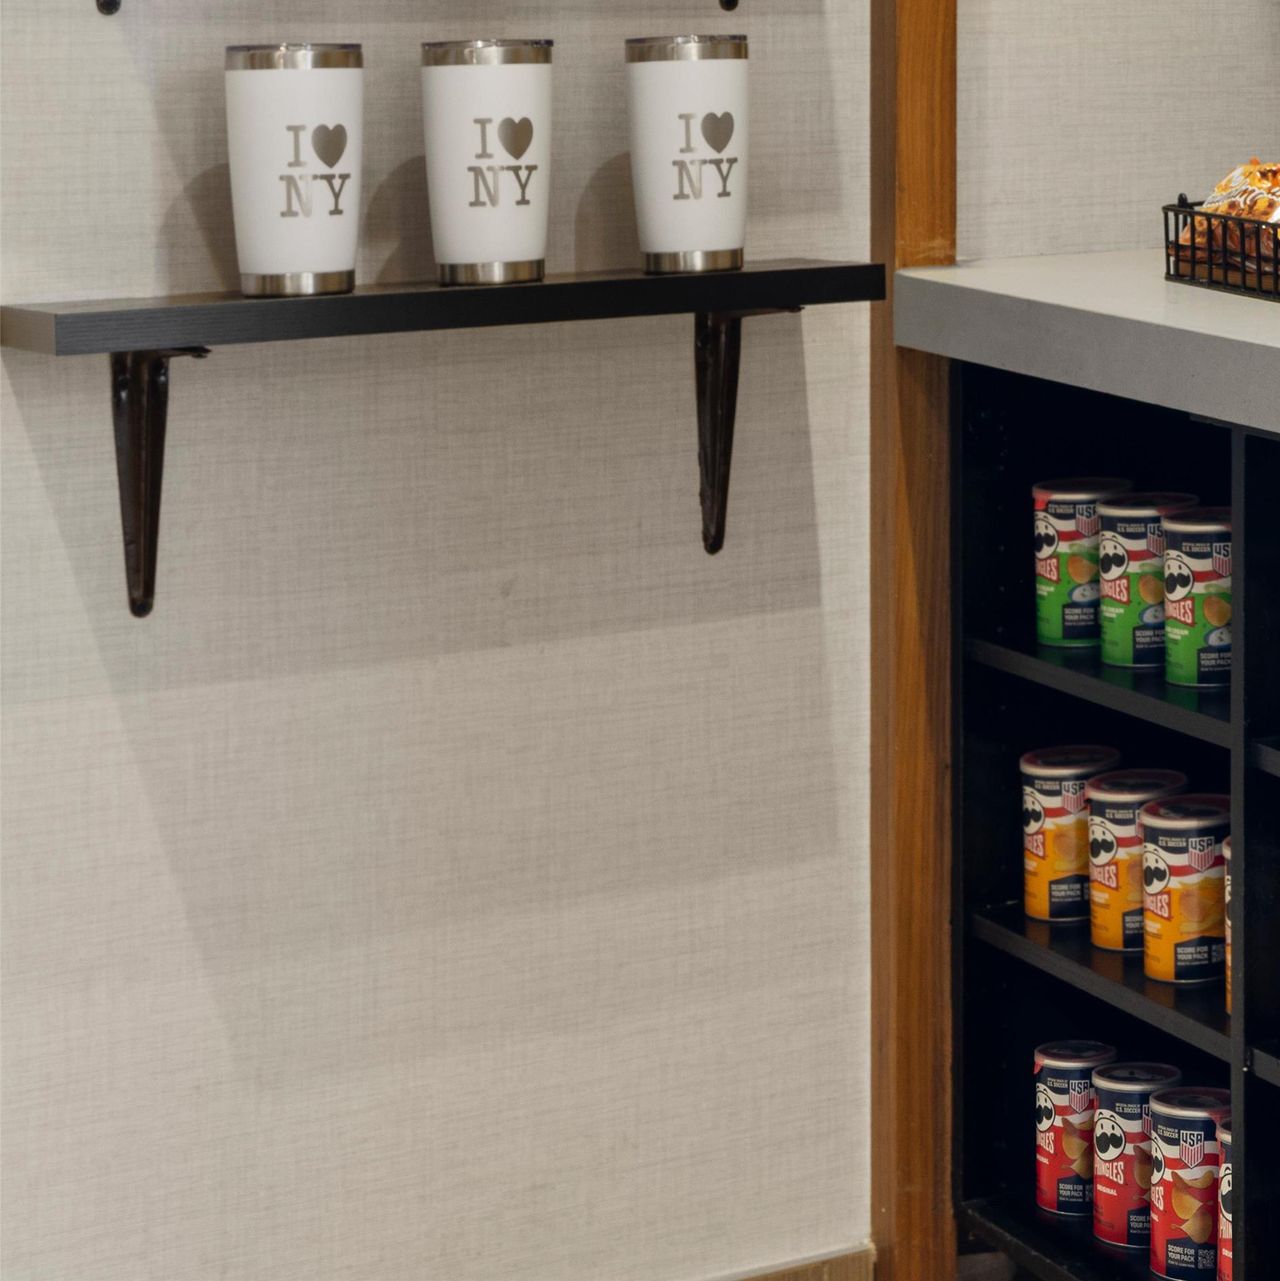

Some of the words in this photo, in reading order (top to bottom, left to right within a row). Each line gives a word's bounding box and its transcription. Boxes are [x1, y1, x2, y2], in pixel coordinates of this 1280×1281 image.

[286, 124, 306, 169] I
[473, 117, 494, 159] I
[678, 112, 698, 154] I
[279, 173, 350, 218] NY
[467, 164, 538, 207] NY
[673, 157, 738, 200] NY
